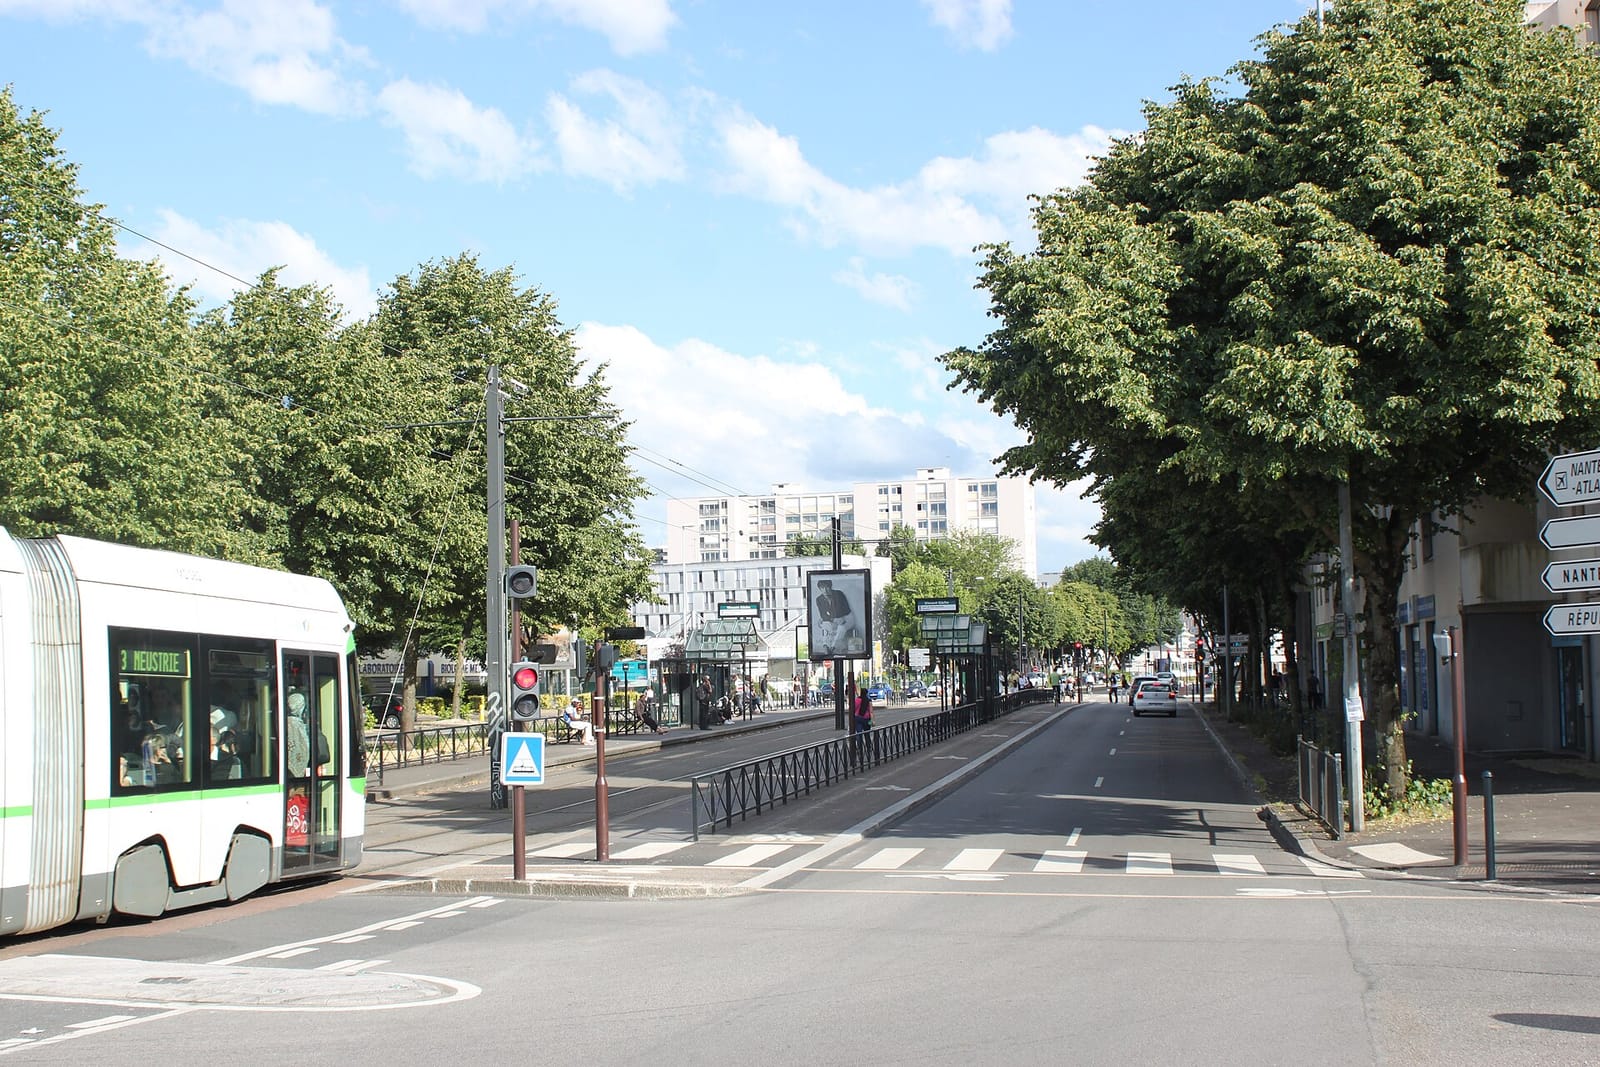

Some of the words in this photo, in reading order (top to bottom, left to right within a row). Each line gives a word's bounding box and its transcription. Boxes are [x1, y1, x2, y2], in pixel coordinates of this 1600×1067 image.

[1568, 609, 1600, 626] RÉPU
[121, 649, 127, 670] 3
[133, 650, 179, 672] NEUSTRIE
